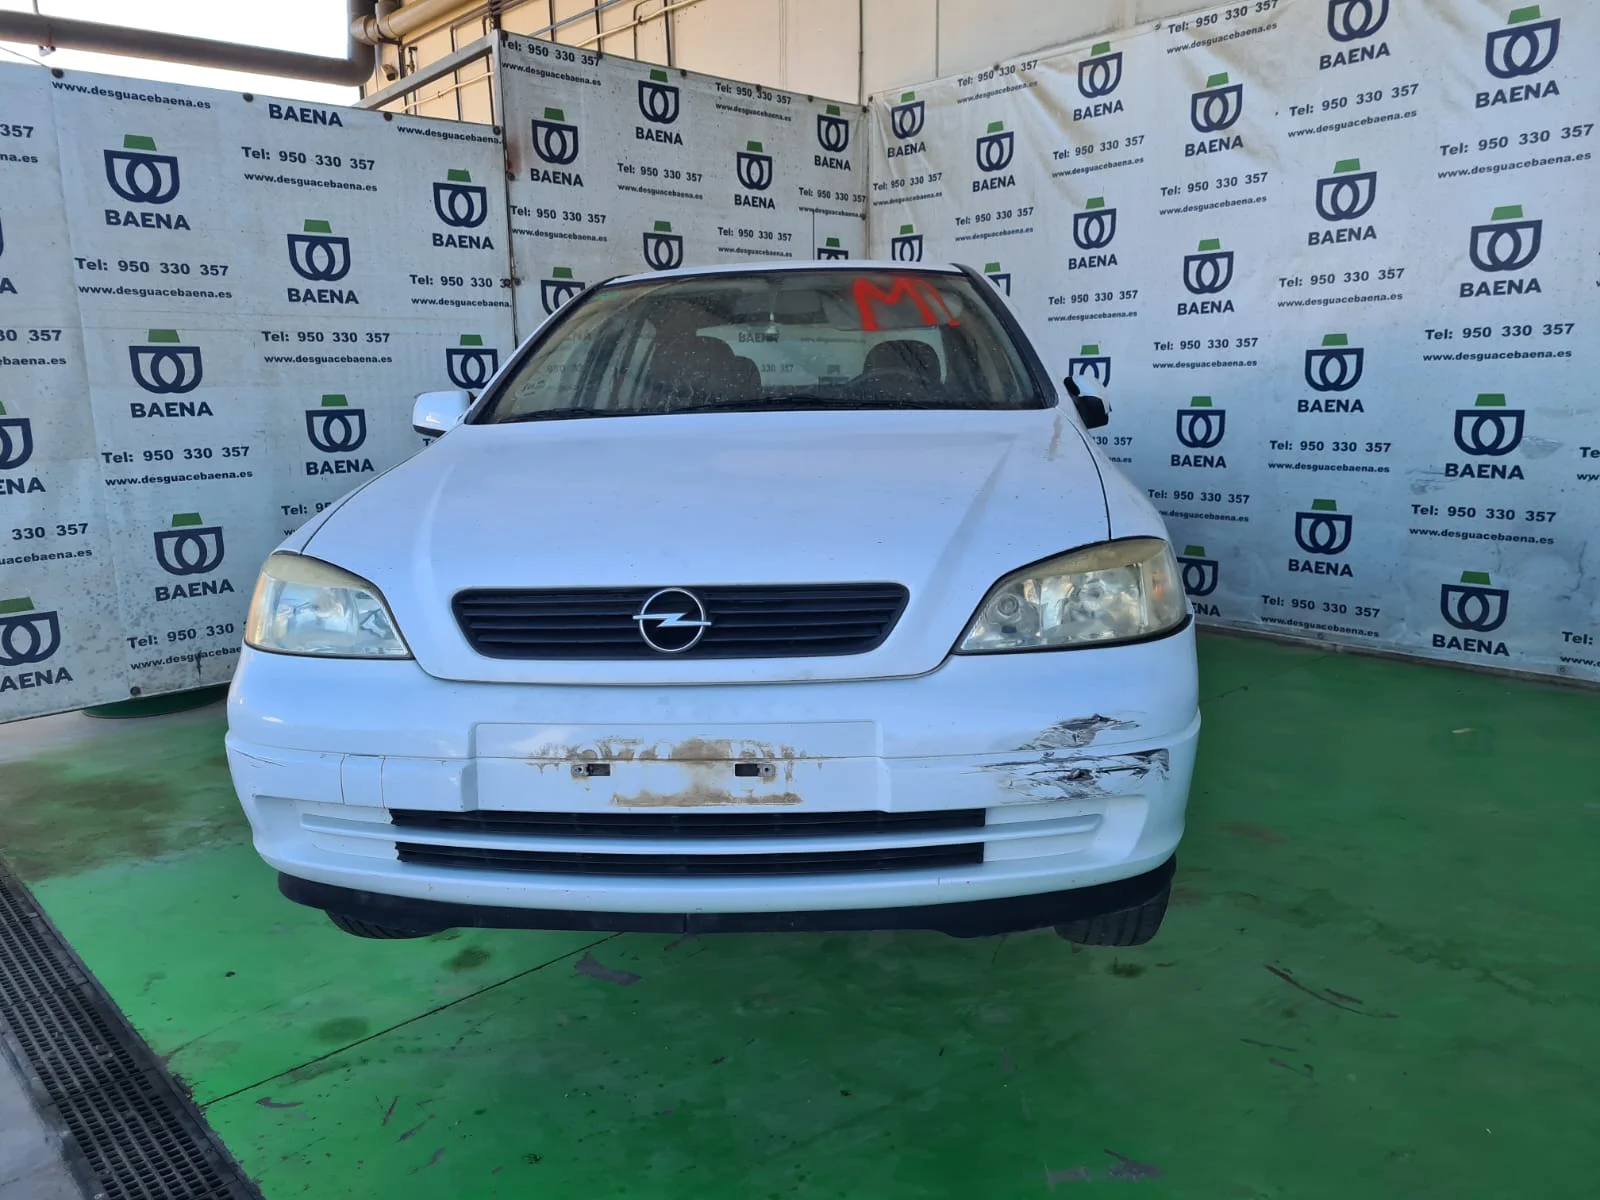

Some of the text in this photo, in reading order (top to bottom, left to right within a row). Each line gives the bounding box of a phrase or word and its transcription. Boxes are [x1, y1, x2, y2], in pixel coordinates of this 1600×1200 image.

[1168, 0, 1278, 34] Tel: 950 330 357
[1167, 22, 1277, 54] www.desguacebaena.es
[499, 38, 601, 66] Tel: 950 330 357
[1320, 42, 1390, 70] BAENA
[52, 81, 211, 109] www.desguacebaena.es
[715, 82, 791, 104] Tel: 950 330 357
[1289, 83, 1419, 116] Tel: 950 330 357
[1476, 80, 1559, 108] BAENA
[269, 104, 343, 127] BAENA
[1073, 100, 1123, 121] BAENA
[1288, 110, 1416, 137] www.desguacebaena.es
[636, 127, 683, 145] BAENA
[1440, 124, 1594, 156] Tel: 950 330 357
[888, 142, 926, 158] BAENA
[1053, 135, 1144, 160] Tel: 950 330 357
[1185, 135, 1244, 157] BAENA
[241, 147, 374, 170] Tel: 950 330 357
[815, 155, 851, 171] BAENA
[1438, 152, 1591, 178] www.desguacebaena.es
[530, 168, 583, 187] BAENA
[617, 163, 702, 182] Tel: 950 330 357
[244, 174, 377, 191] www.desguacebaena.es
[973, 175, 1015, 192] BAENA
[1161, 172, 1268, 196] Tel: 950 330 357
[735, 194, 775, 209] BAENA
[1160, 194, 1267, 215] www.desguacebaena.es
[105, 210, 190, 230] BAENA
[510, 205, 606, 224] Tel: 950 330 357
[955, 207, 1034, 225] Tel: 950 330 357
[432, 233, 494, 250] BAENA
[718, 227, 792, 241] Tel: 950 330 357
[1308, 226, 1376, 245] BAENA
[74, 258, 228, 276] Tel: 950 330 357
[1069, 254, 1117, 270] BAENA
[409, 274, 433, 285] Tel:
[441, 276, 463, 286] 950
[471, 277, 492, 287] 330
[1279, 268, 1404, 287] Tel: 950 330 357
[78, 286, 232, 298] www.desguacebaena.es
[288, 288, 359, 304] BAENA
[1460, 278, 1541, 297] BAENA
[1048, 290, 1138, 304] Tel: 950 330 357
[1278, 294, 1403, 307] www.desguacebaena.es
[1177, 300, 1234, 315] BAENA
[29, 330, 61, 341] 357
[261, 331, 390, 343] Tel: 950 330 357
[1425, 323, 1574, 340] Tel: 950 330 357
[1154, 338, 1258, 350] Tel: 950 330 357
[264, 355, 392, 364] www.desguacebaena.es
[1423, 351, 1571, 361] www.desguacebaena.es
[130, 402, 213, 418] BAENA
[1298, 399, 1364, 412] BAENA
[1114, 437, 1132, 446] 357
[1270, 440, 1391, 452] Tel: 950 330 357
[101, 446, 249, 463] Tel: 950 330 357
[1171, 455, 1226, 468] BAENA
[306, 459, 374, 475] BAENA
[1268, 462, 1389, 472] www.desguacebaena.es
[1445, 463, 1524, 480] BAENA
[105, 471, 253, 485] www.desguacebaena.es
[1148, 489, 1249, 504] Tel: 950 330 357
[281, 504, 307, 515] Tel:
[1411, 504, 1556, 522] Tel: 950 330 357
[12, 523, 88, 540] 330 357
[1409, 529, 1554, 544] www.desguacebaena.es
[1288, 559, 1353, 577] BAENA
[155, 579, 235, 601] BAENA
[1261, 595, 1380, 618] Tel: 950 330 357
[1261, 616, 1379, 637] www.desguacebaena.es
[127, 623, 234, 649] Tel: 950 330
[1562, 632, 1593, 645] Tel:
[1433, 634, 1509, 656] BAENA
